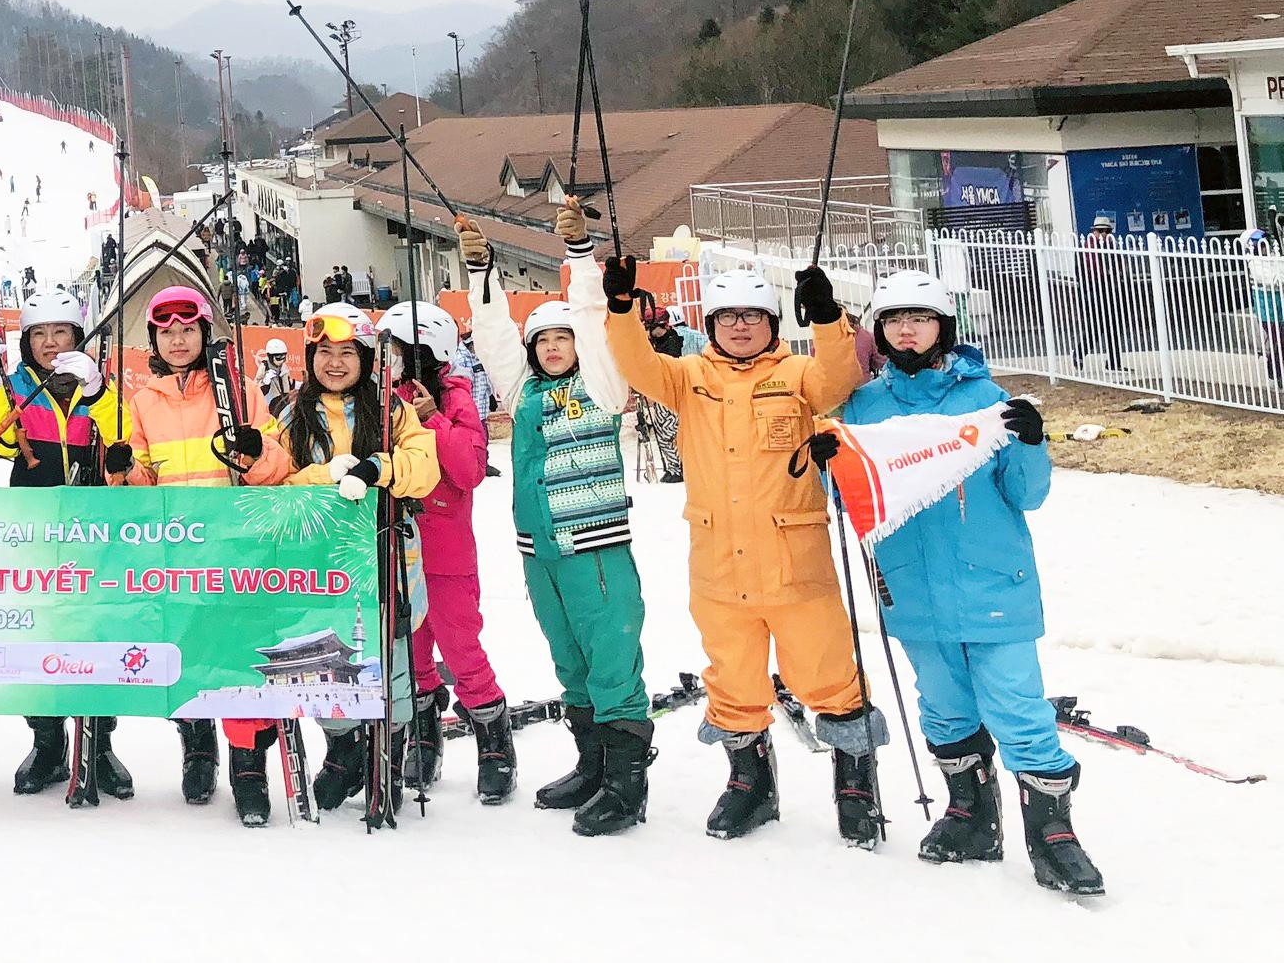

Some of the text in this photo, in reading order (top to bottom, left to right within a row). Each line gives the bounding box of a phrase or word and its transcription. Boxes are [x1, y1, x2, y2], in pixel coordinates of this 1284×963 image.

[961, 185, 975, 205] 서울
[976, 187, 1000, 205] YMCA
[886, 439, 962, 472] Follow me
[44, 517, 111, 544] HÀN
[119, 515, 205, 545] QUỐC
[125, 568, 225, 594] LOTTE
[229, 568, 352, 596] WORLD
[42, 654, 95, 674] Okela
